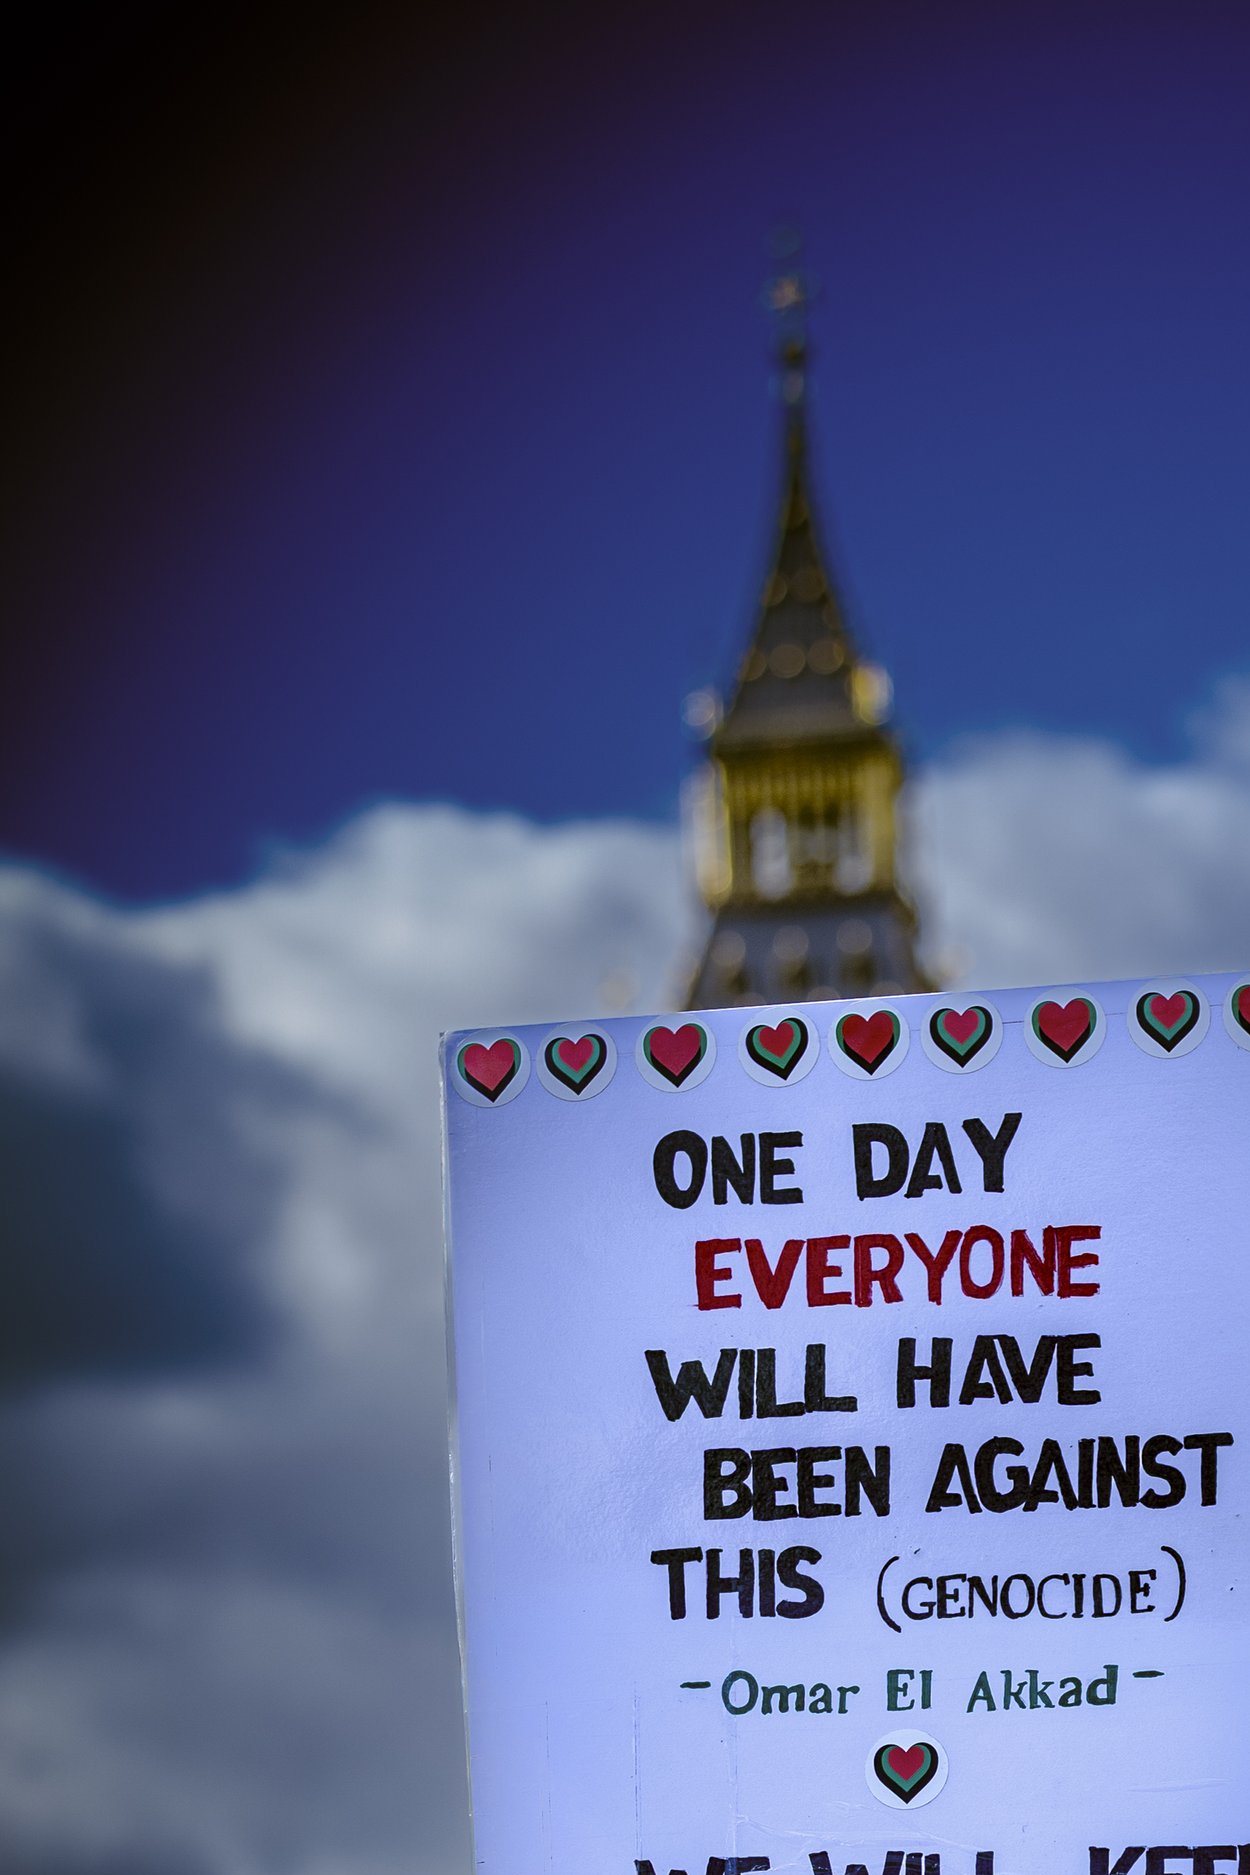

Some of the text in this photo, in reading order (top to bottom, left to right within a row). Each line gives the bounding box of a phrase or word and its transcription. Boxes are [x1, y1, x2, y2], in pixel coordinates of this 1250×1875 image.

[653, 1113, 1022, 1209] ONE DAY
[695, 1225, 1101, 1311] EVERYONE
[645, 1333, 1101, 1422] WILL HAVE
[704, 1432, 1234, 1521] BEEN AGAINST
[651, 1546, 1186, 1633] THIS (GENOCIDE)
[887, 1670, 932, 1711] El
